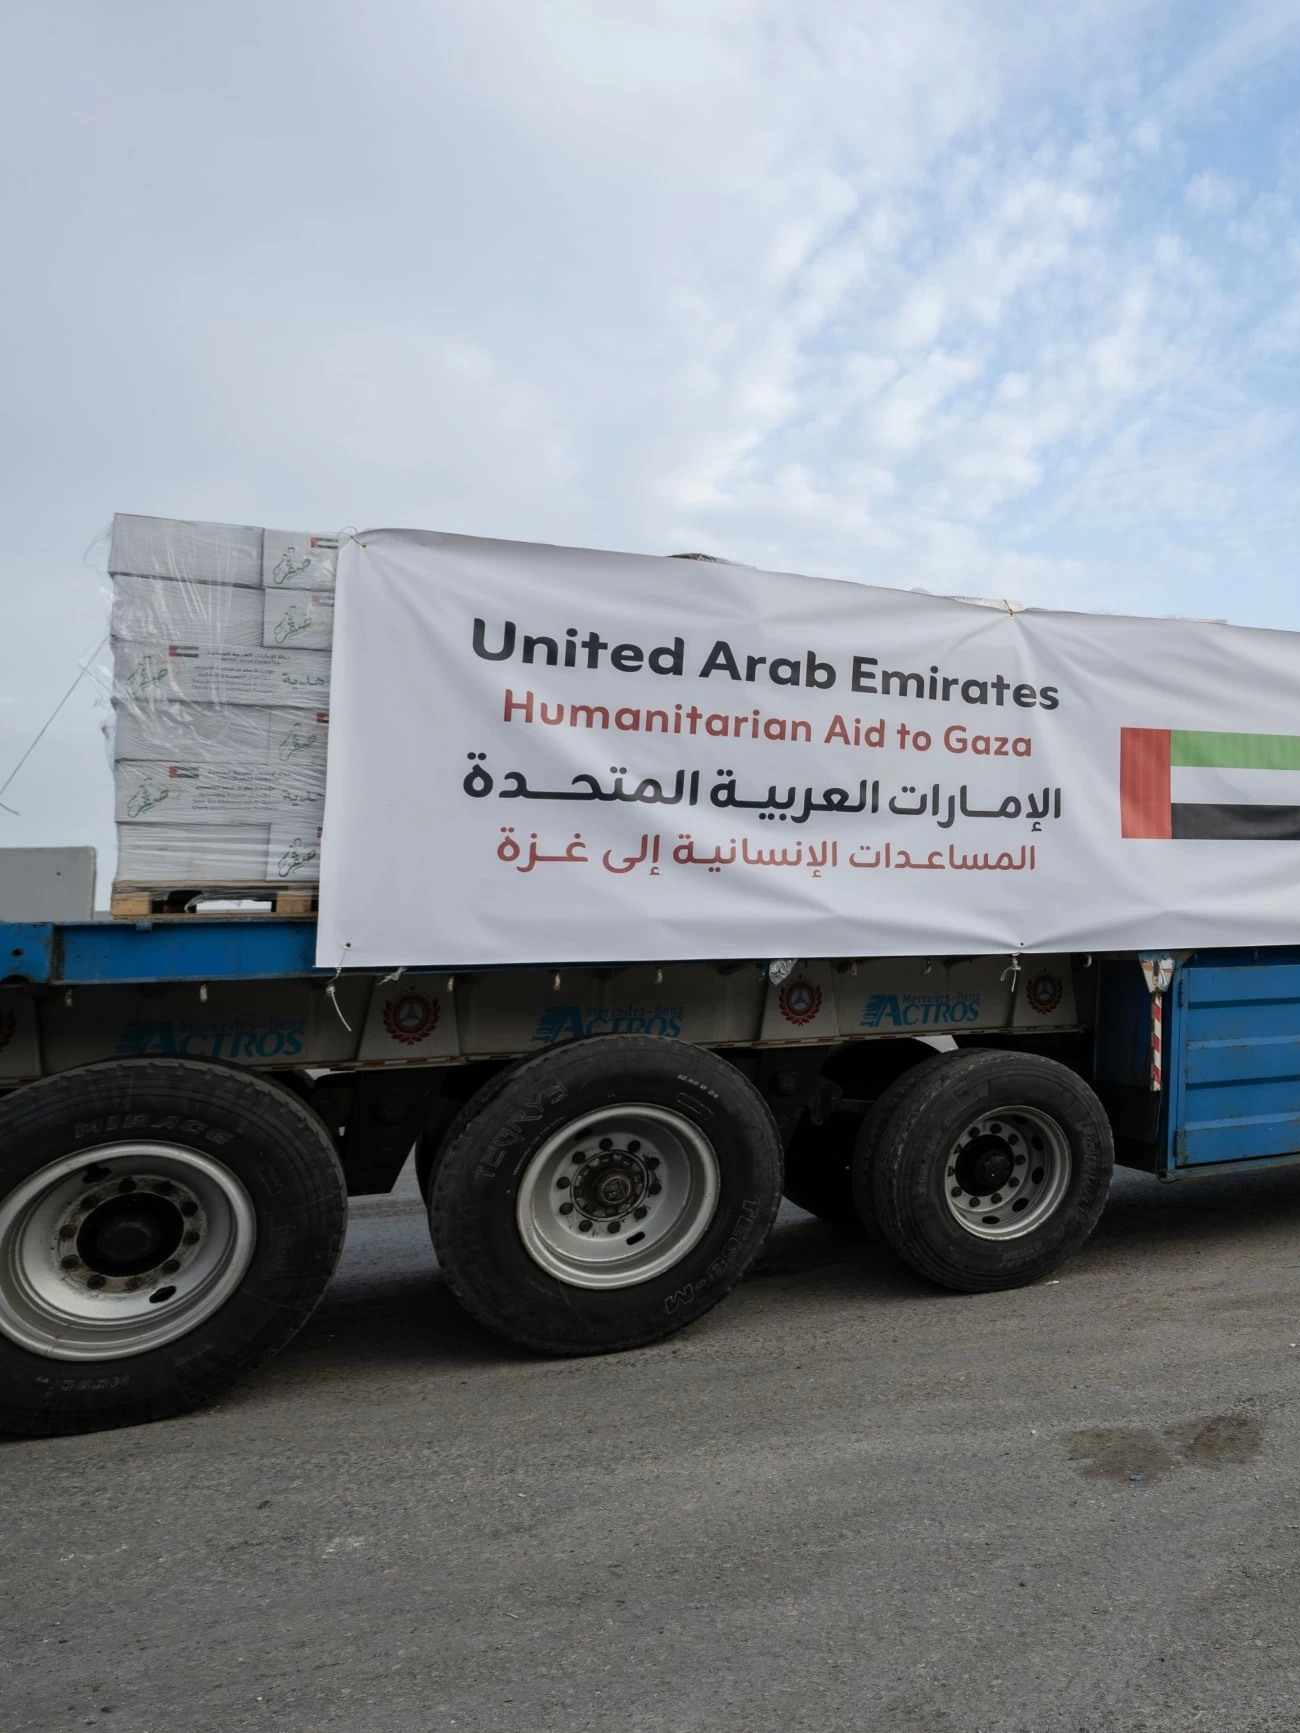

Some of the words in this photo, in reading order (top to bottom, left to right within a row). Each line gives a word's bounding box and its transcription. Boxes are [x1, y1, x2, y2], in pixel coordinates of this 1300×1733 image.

[472, 618, 685, 676] United
[699, 640, 836, 690] Arab
[851, 656, 1060, 710] Emirates
[503, 688, 812, 743] Humanitarian
[824, 715, 886, 748] Aid
[897, 722, 932, 752] to
[944, 725, 1032, 758] Gaza
[463, 751, 700, 807] المتحدة
[710, 768, 880, 824] العربية
[888, 784, 1062, 833] الإمارات
[497, 826, 589, 873] غزة
[602, 834, 661, 876] إلى
[673, 834, 838, 878] الإنسانية
[849, 842, 1036, 871] المساعدات
[902, 991, 981, 1004] Mercedes-Benz
